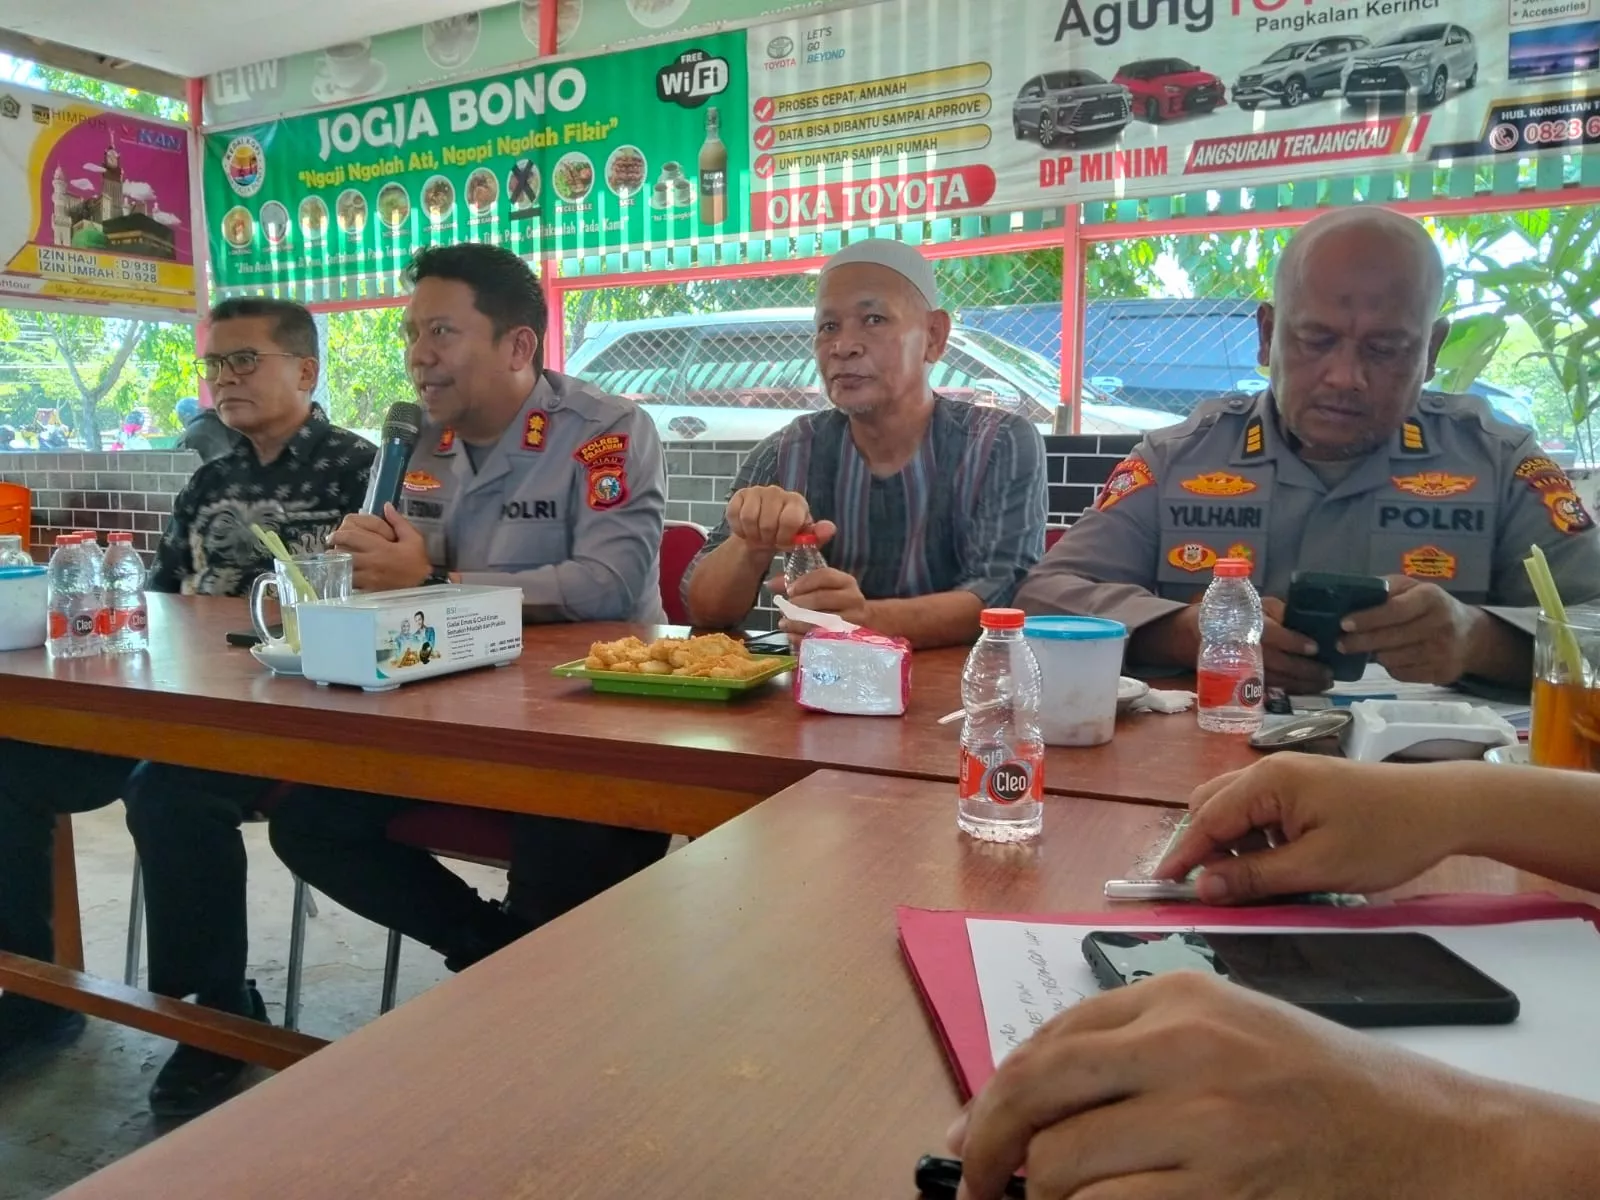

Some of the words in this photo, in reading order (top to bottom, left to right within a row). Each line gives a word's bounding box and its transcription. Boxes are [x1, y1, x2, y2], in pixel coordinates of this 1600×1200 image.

[1054, 0, 1213, 46] Agung
[1255, 5, 1358, 33] Pangkalan
[1521, 2, 1586, 19] Accessories
[806, 26, 832, 41] LET'S
[680, 52, 703, 64] FREE
[806, 41, 820, 52] GO
[806, 49, 846, 64] BEYOND
[763, 58, 796, 71] TOYOTA
[778, 98, 819, 113] PROSES
[821, 90, 857, 107] CEPAT,
[859, 82, 907, 101] AMANAH
[317, 97, 440, 161] JOGJA
[448, 67, 587, 132] BONO
[778, 127, 804, 142] DATA
[806, 124, 831, 137] BISA
[833, 115, 879, 134] DIBANTU
[882, 108, 925, 127] SAMPAI
[927, 100, 981, 120] APPROVE
[1501, 109, 1527, 120] HUB.
[1529, 102, 1592, 118] KONSULTAN
[1524, 118, 1583, 145] 0823
[349, 156, 404, 180] Ngolah
[408, 151, 439, 170] Ati,
[442, 141, 492, 166] Ngopi
[497, 127, 558, 156] Ngolah
[778, 156, 802, 171] UNIT
[804, 149, 850, 167] DIANTAR
[851, 143, 894, 160] SAMPAI
[896, 138, 938, 155] RUMAH
[1192, 137, 1278, 168] ANGSURAN
[1283, 125, 1391, 157] TERJANGKAU
[1039, 156, 1074, 188] DP
[1080, 146, 1168, 183] MINIM
[767, 190, 834, 224] OKA
[843, 173, 969, 217] TOYOTA
[38, 248, 65, 261] IZIN
[68, 253, 98, 266] HAJI
[121, 259, 157, 273] D/938
[39, 261, 66, 273] IZIN
[68, 264, 115, 278] UMRAH
[122, 270, 157, 284] D/928
[581, 436, 620, 456] POLRES
[1169, 506, 1262, 529] YULHAIRI
[1379, 506, 1485, 532] POLRI
[76, 619, 93, 631] Cleo
[996, 771, 1027, 792] Cleo
